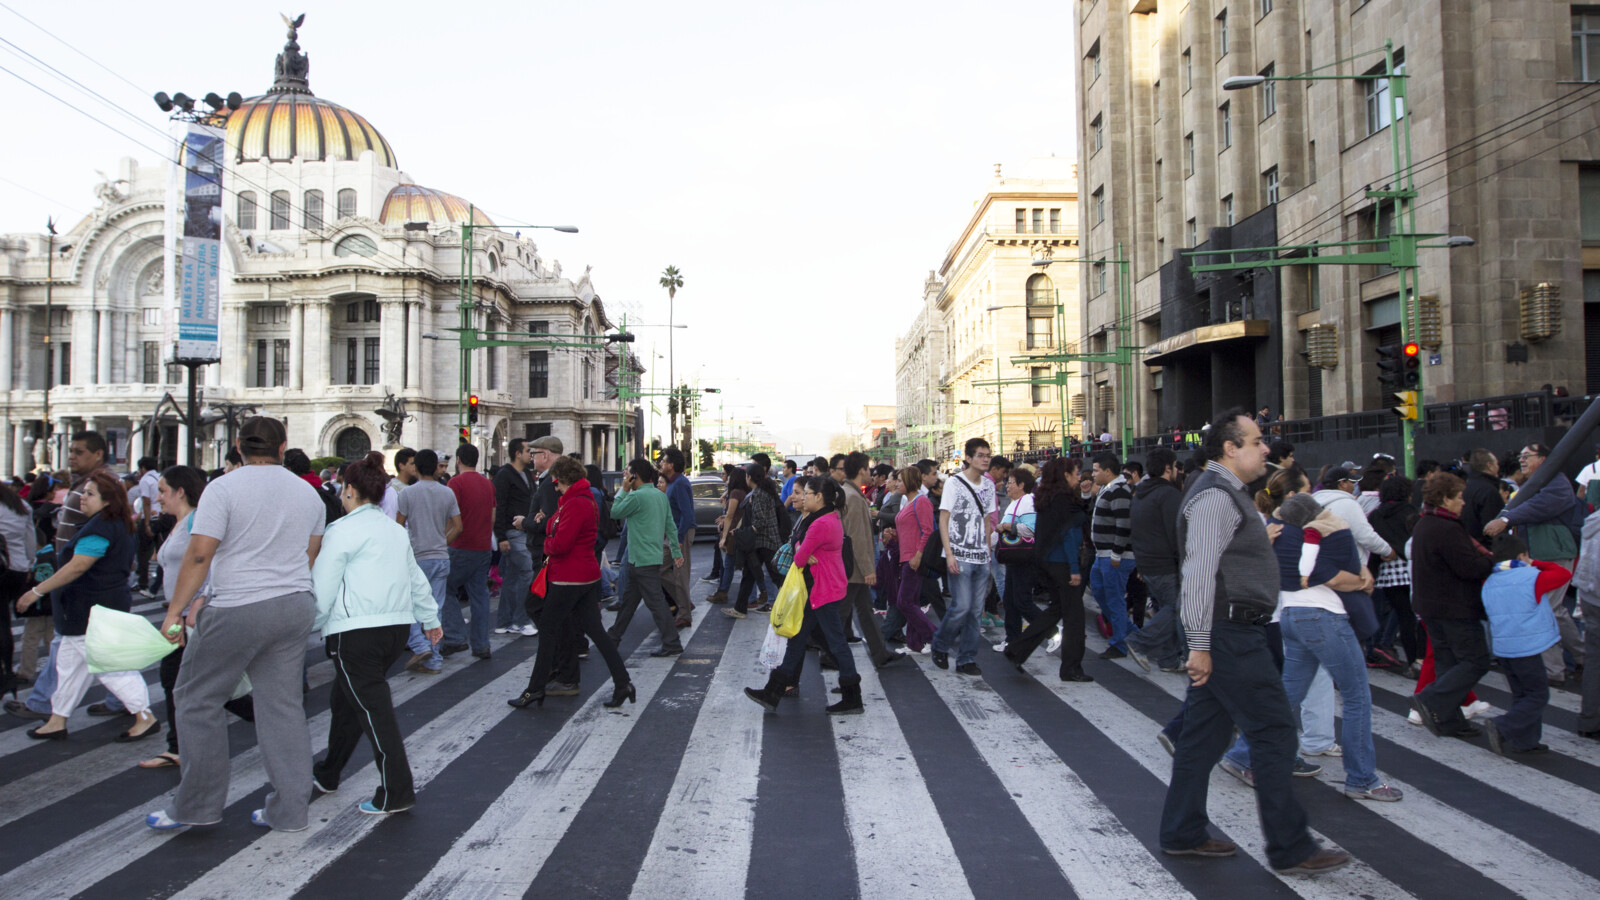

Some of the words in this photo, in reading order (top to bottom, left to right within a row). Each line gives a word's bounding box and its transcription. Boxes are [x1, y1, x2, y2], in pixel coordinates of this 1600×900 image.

[184, 241, 195, 255] DE
[209, 244, 218, 277] SALUD
[183, 264, 193, 318] MUESTRA
[195, 243, 206, 319] ARQUITECTURA
[208, 279, 217, 292] LA
[207, 294, 217, 320] PARA
